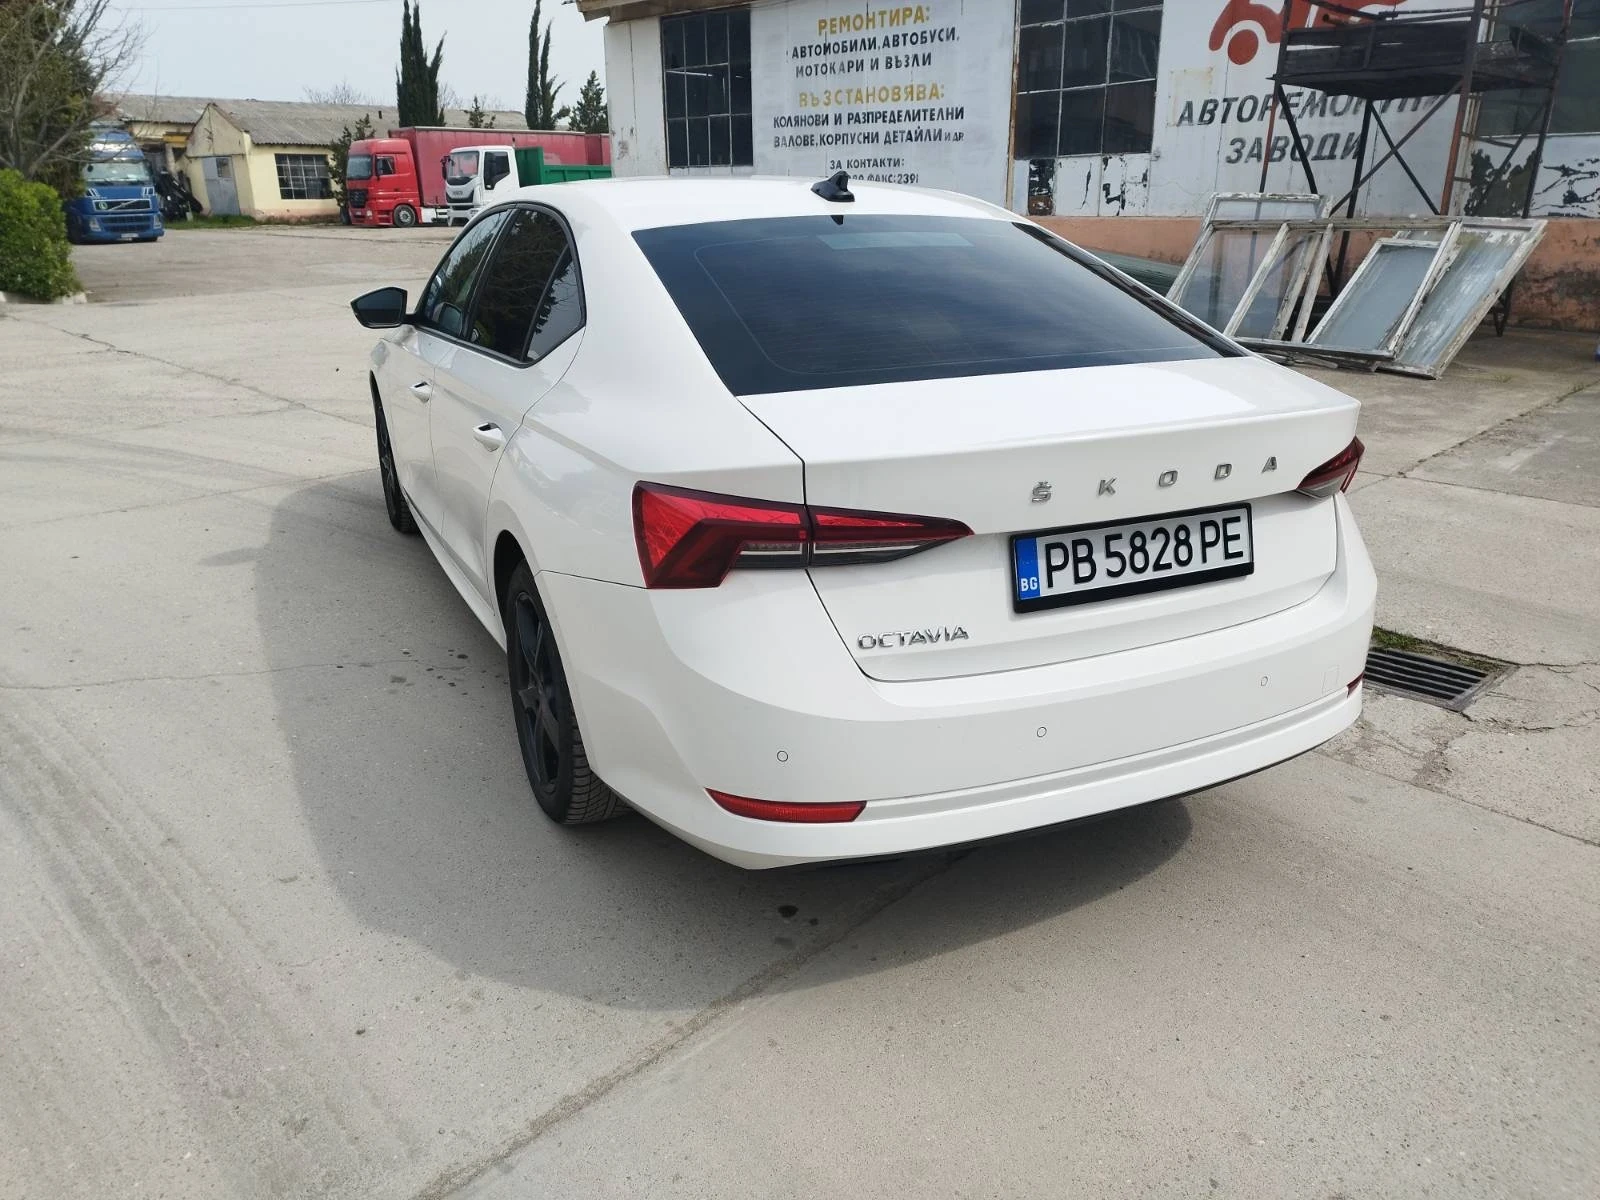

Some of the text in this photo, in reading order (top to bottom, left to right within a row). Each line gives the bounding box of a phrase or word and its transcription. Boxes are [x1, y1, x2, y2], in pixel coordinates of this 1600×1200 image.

[818, 5, 931, 36] РЕМОНТИРА:
[795, 52, 932, 78] МОТОКАРИ И ВЪЗЛИ
[799, 82, 945, 108] ВЪЗСТАНОВЯВА:
[773, 107, 965, 128] КОЛЯНОВИ И РАЗПРЕДЕЛИТЕЛНИ
[884, 126, 942, 145] ДЕТАЙЛИ
[830, 158, 905, 170] ЗА КОНТАКТИ:
[1045, 516, 1244, 588] PB 5828 PE
[1020, 576, 1038, 592] BG
[857, 626, 970, 650] OCTAVIA
